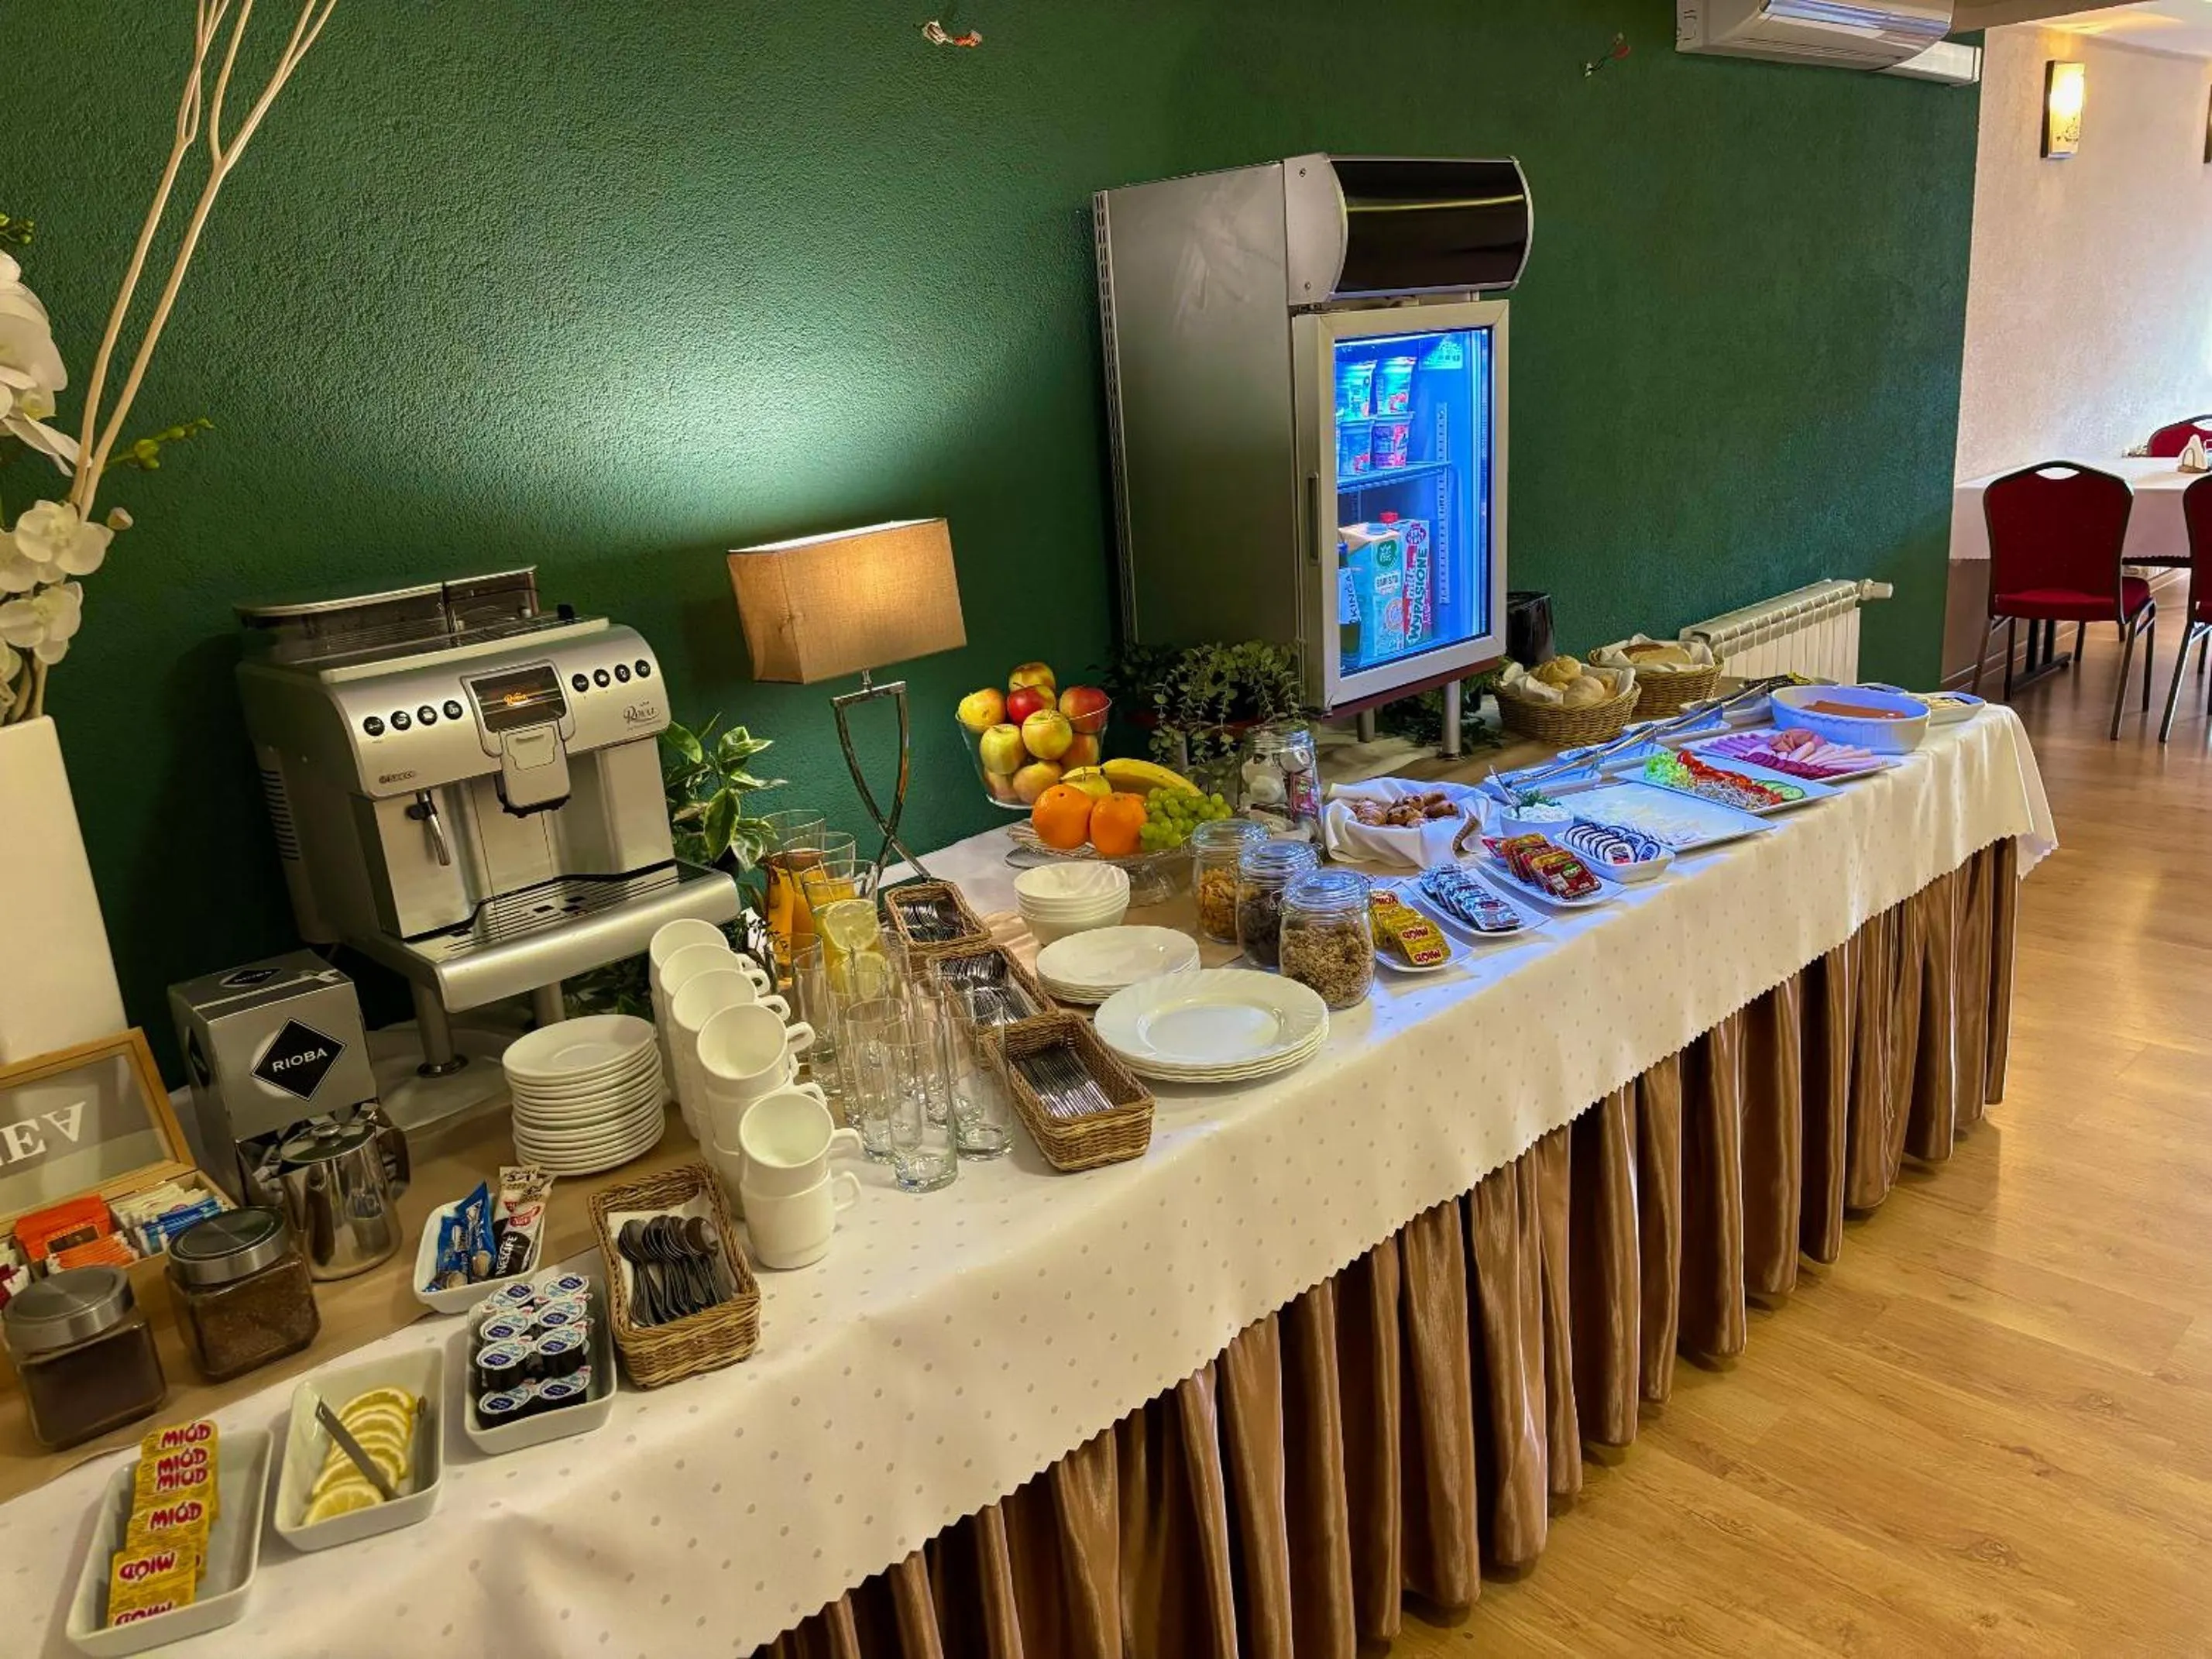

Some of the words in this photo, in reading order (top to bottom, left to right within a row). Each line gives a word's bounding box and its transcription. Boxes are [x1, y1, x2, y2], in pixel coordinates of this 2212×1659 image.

[272, 1047, 328, 1073] RIOBA
[161, 1422, 211, 1448] MIÓD
[150, 1502, 202, 1530] MIÓD
[119, 1552, 175, 1581] MIÓD
